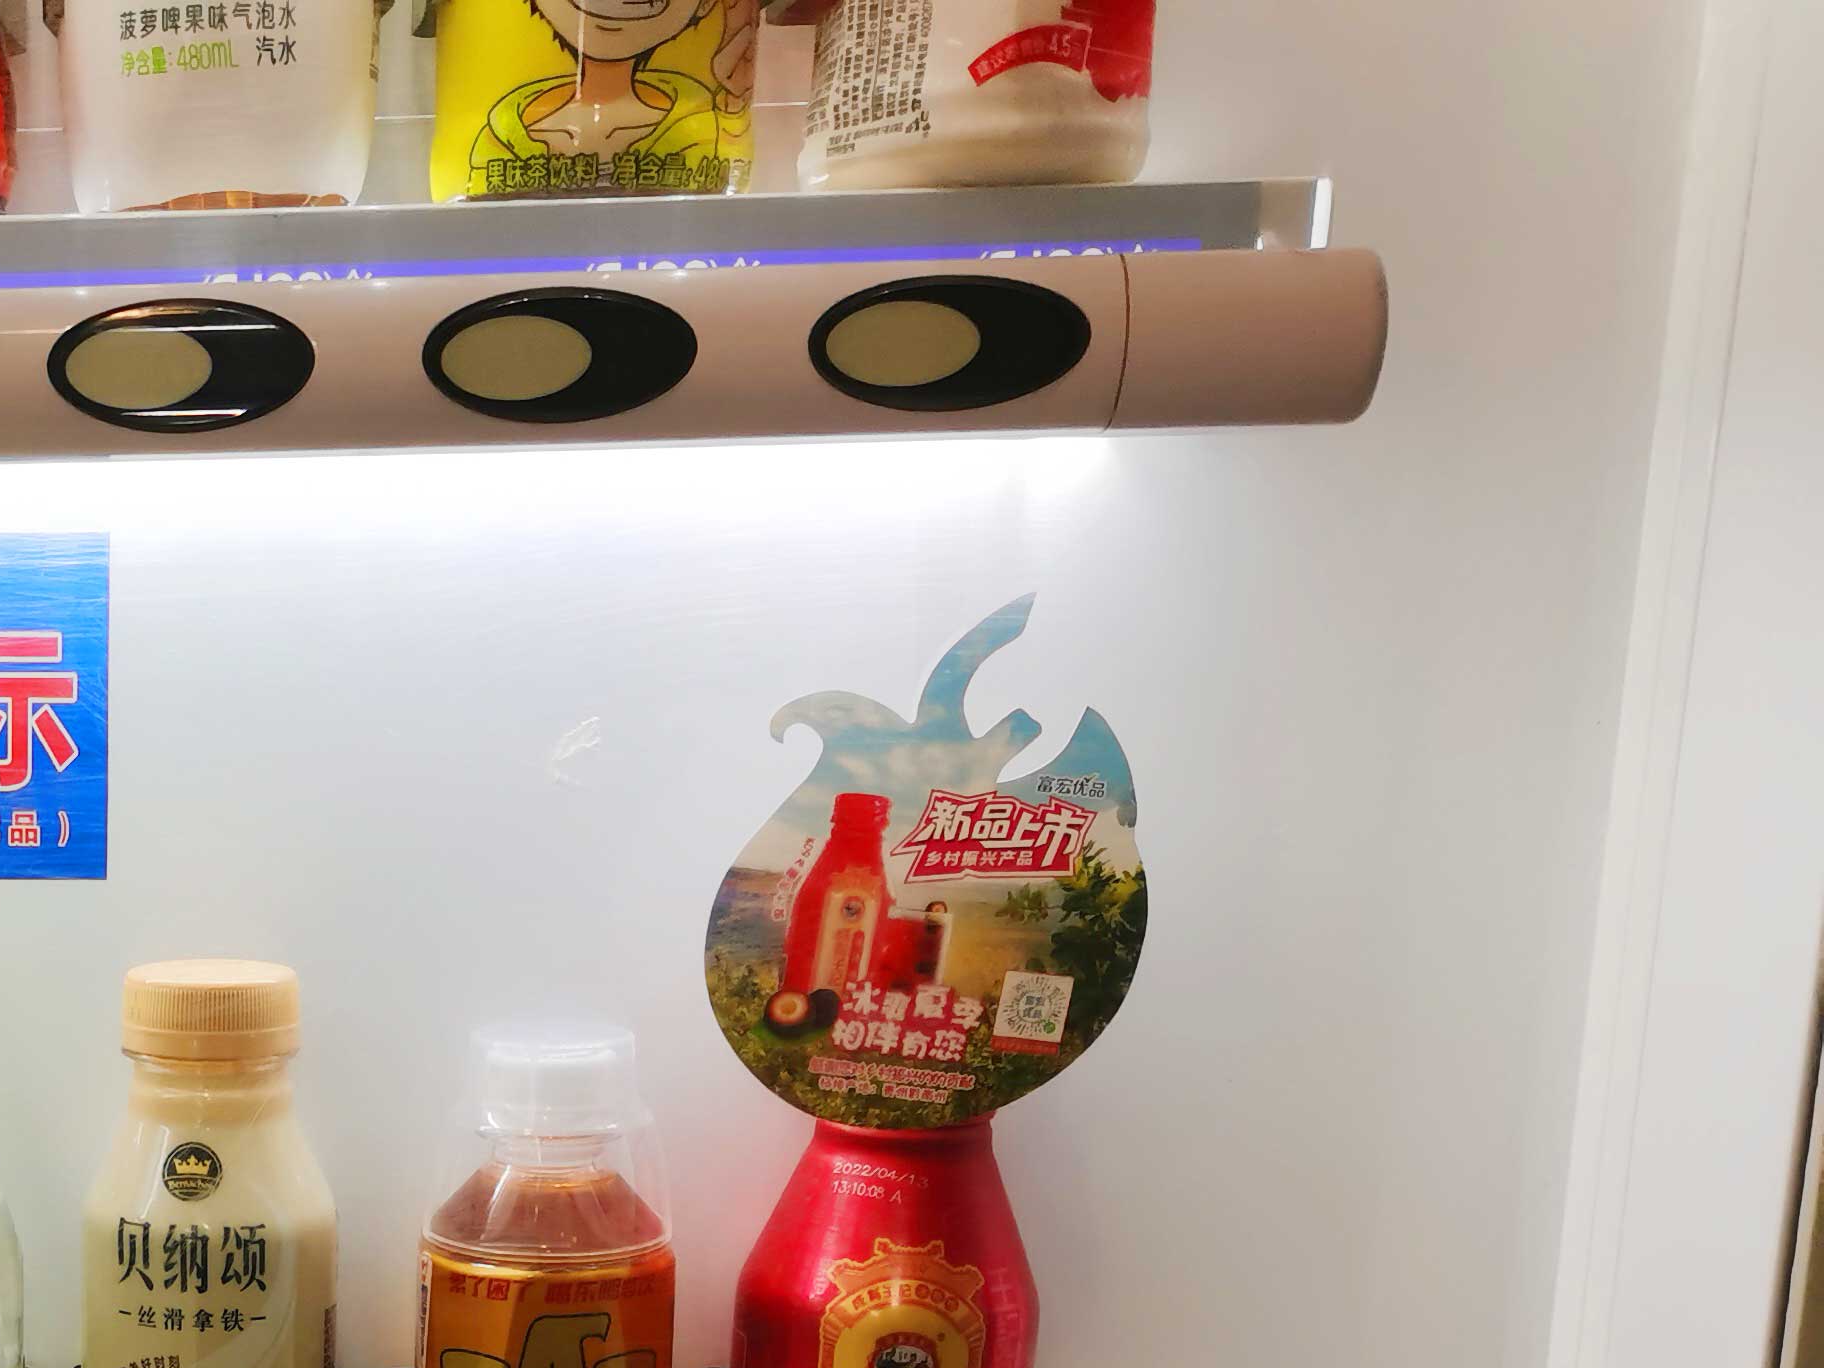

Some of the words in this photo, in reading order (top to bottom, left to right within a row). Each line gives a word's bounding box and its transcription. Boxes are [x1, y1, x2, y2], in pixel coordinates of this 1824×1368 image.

[119, 0, 297, 41] 菠萝啤果味气泡水
[255, 35, 297, 66] 汽水
[485, 154, 599, 191] 果味茶饮料
[1036, 772, 1106, 798] 富宏优品
[916, 799, 1085, 868] 新品上市
[117, 1216, 267, 1295] 贝纳颂
